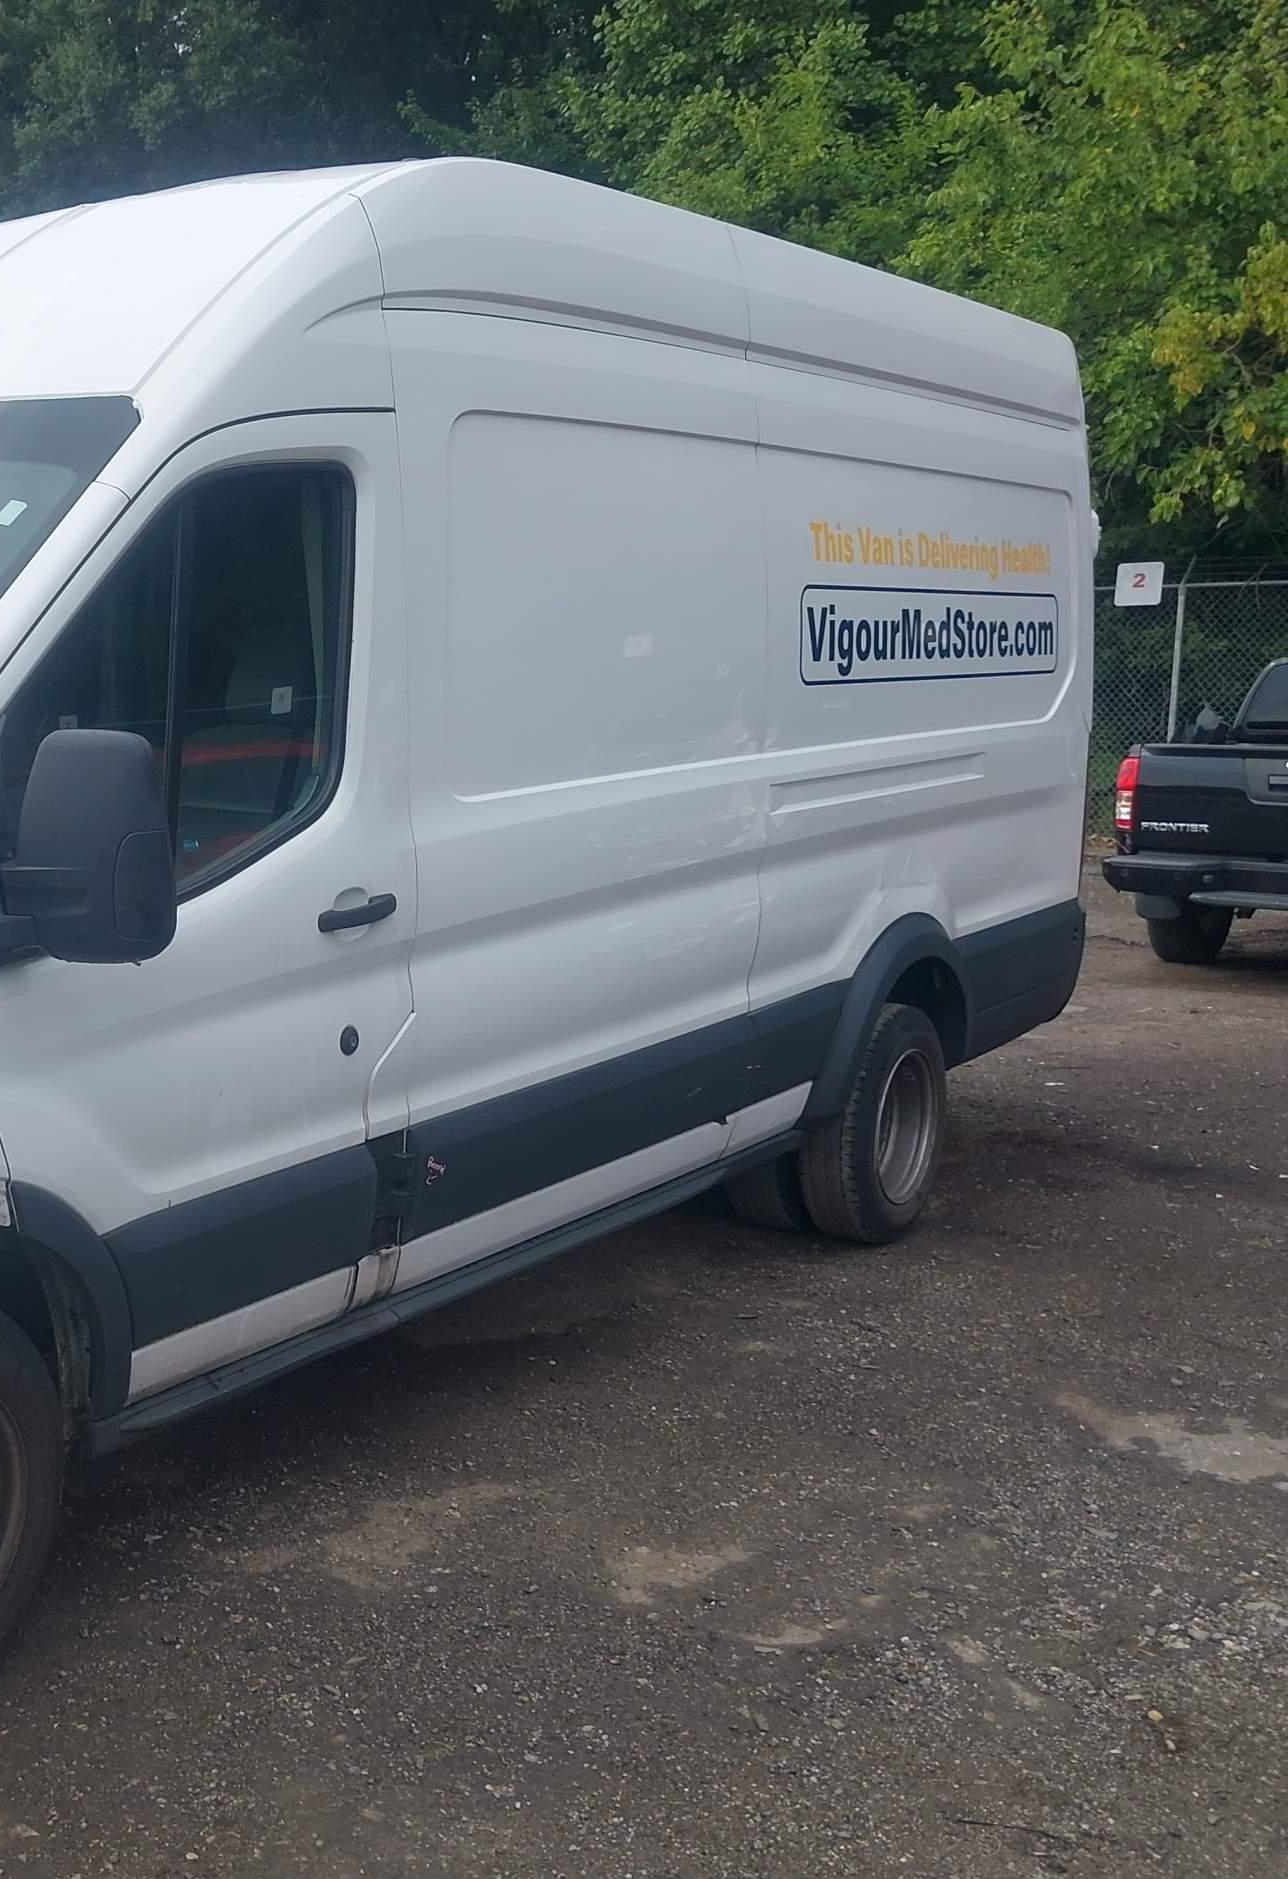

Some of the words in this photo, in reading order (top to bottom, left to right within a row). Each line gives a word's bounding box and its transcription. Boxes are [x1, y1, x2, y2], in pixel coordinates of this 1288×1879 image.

[809, 521, 853, 564] This
[858, 527, 894, 566] Van
[899, 528, 913, 567] is
[918, 532, 999, 581] Delivering
[1131, 573, 1146, 588] 2
[807, 604, 1054, 676] VigourMedStore.com
[1140, 821, 1209, 833] FRONTIER
